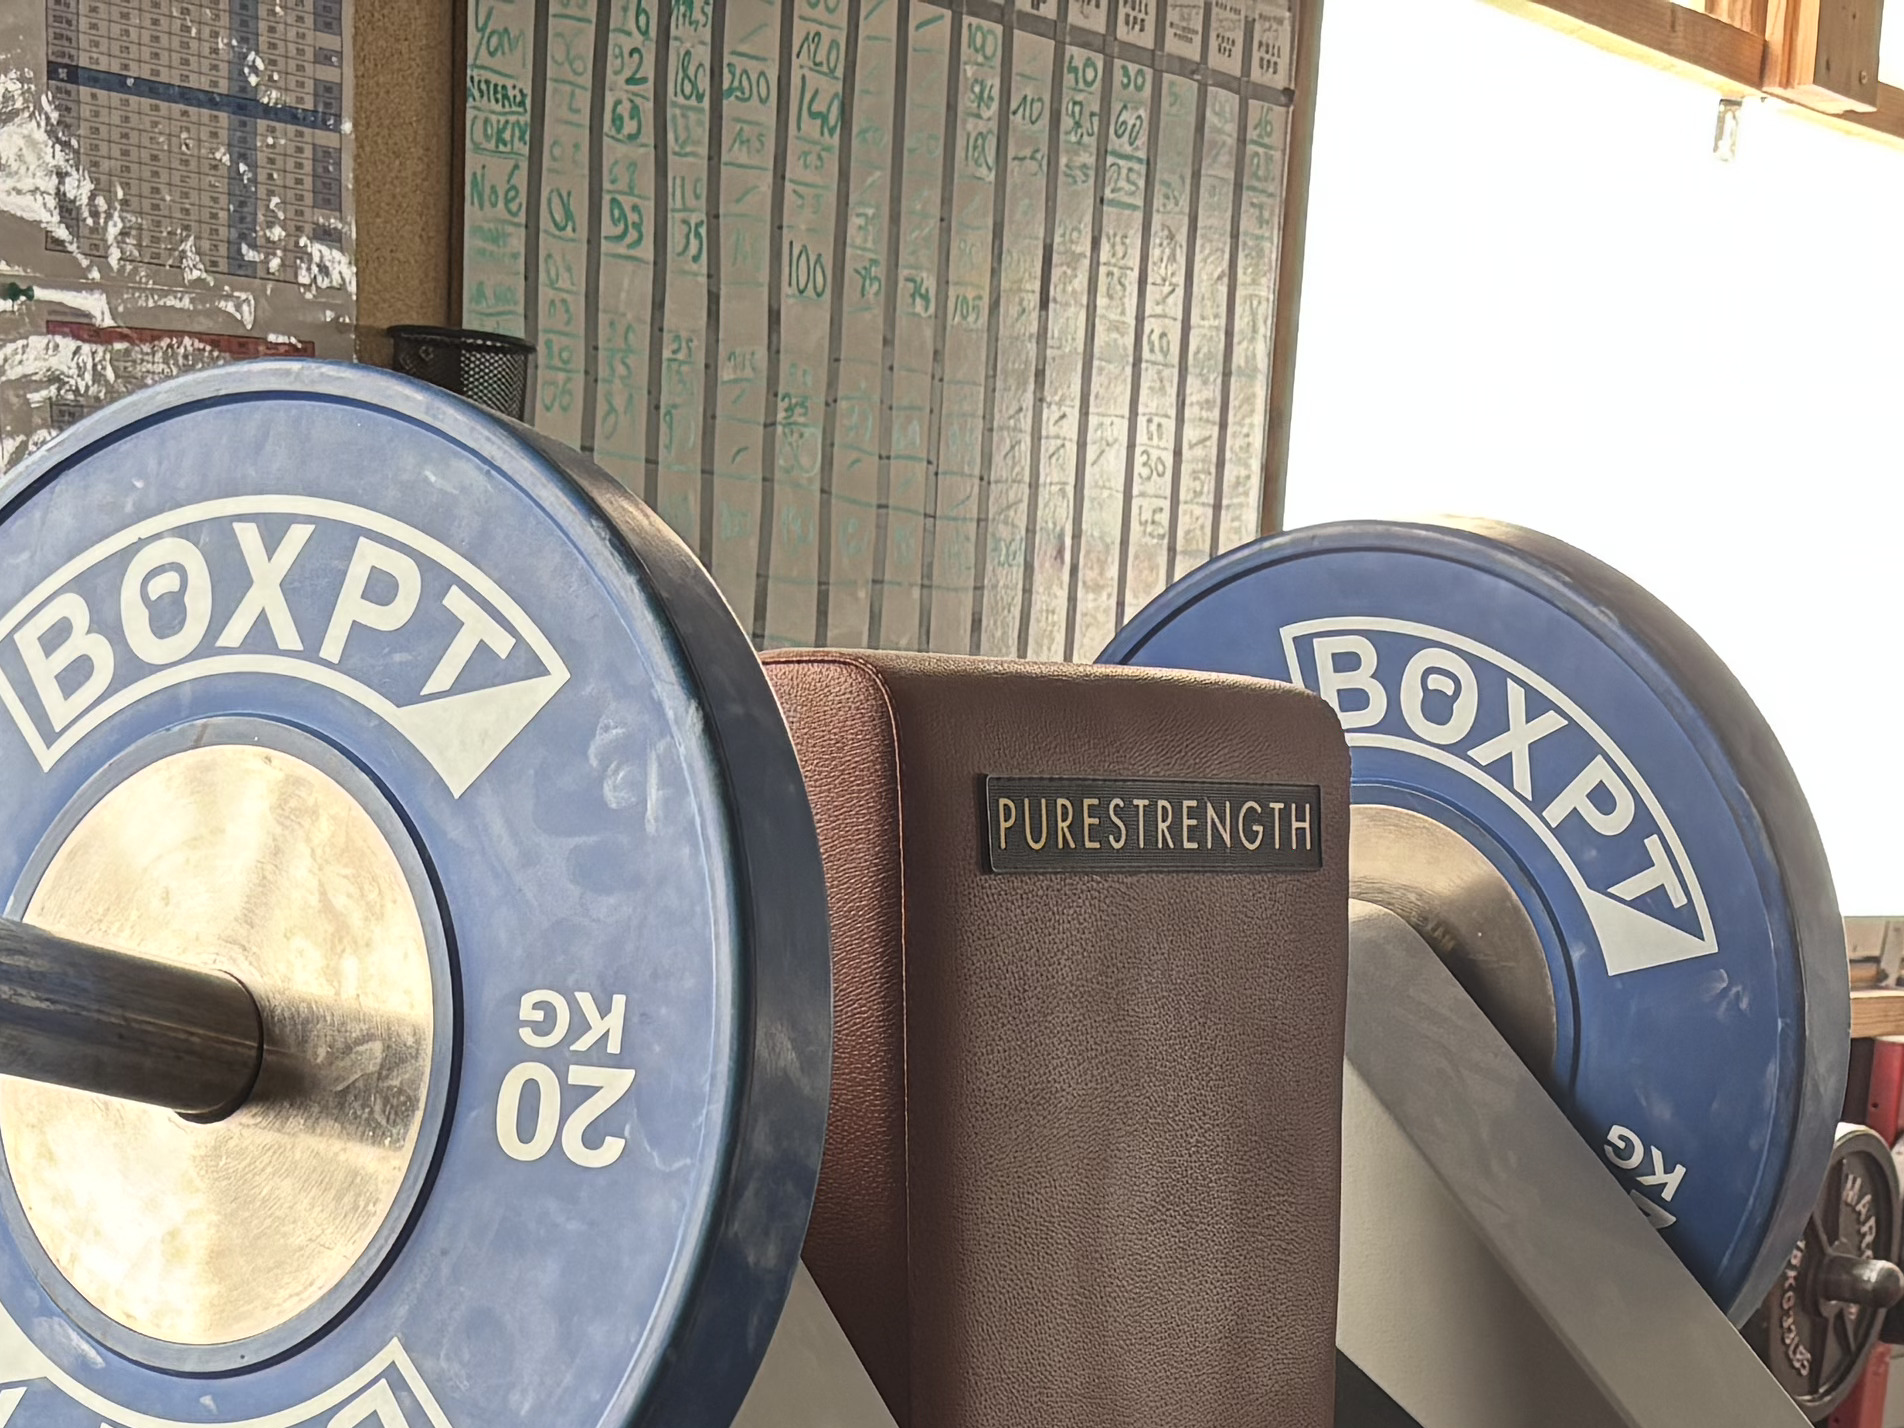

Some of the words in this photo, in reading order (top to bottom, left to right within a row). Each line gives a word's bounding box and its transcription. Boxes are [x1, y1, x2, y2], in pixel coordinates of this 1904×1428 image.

[796, 30, 840, 76] 120
[1011, 93, 1044, 126] 10
[1114, 103, 1144, 148] 60
[469, 163, 524, 218] Noé
[787, 239, 827, 298] 100
[13, 521, 517, 733] BOXPT
[1311, 633, 1689, 924] BOXPT
[997, 796, 1314, 853] PURESTRENGTH
[518, 988, 628, 1056] KG
[495, 1060, 637, 1168] 20
[1603, 1124, 1687, 1203] KG
